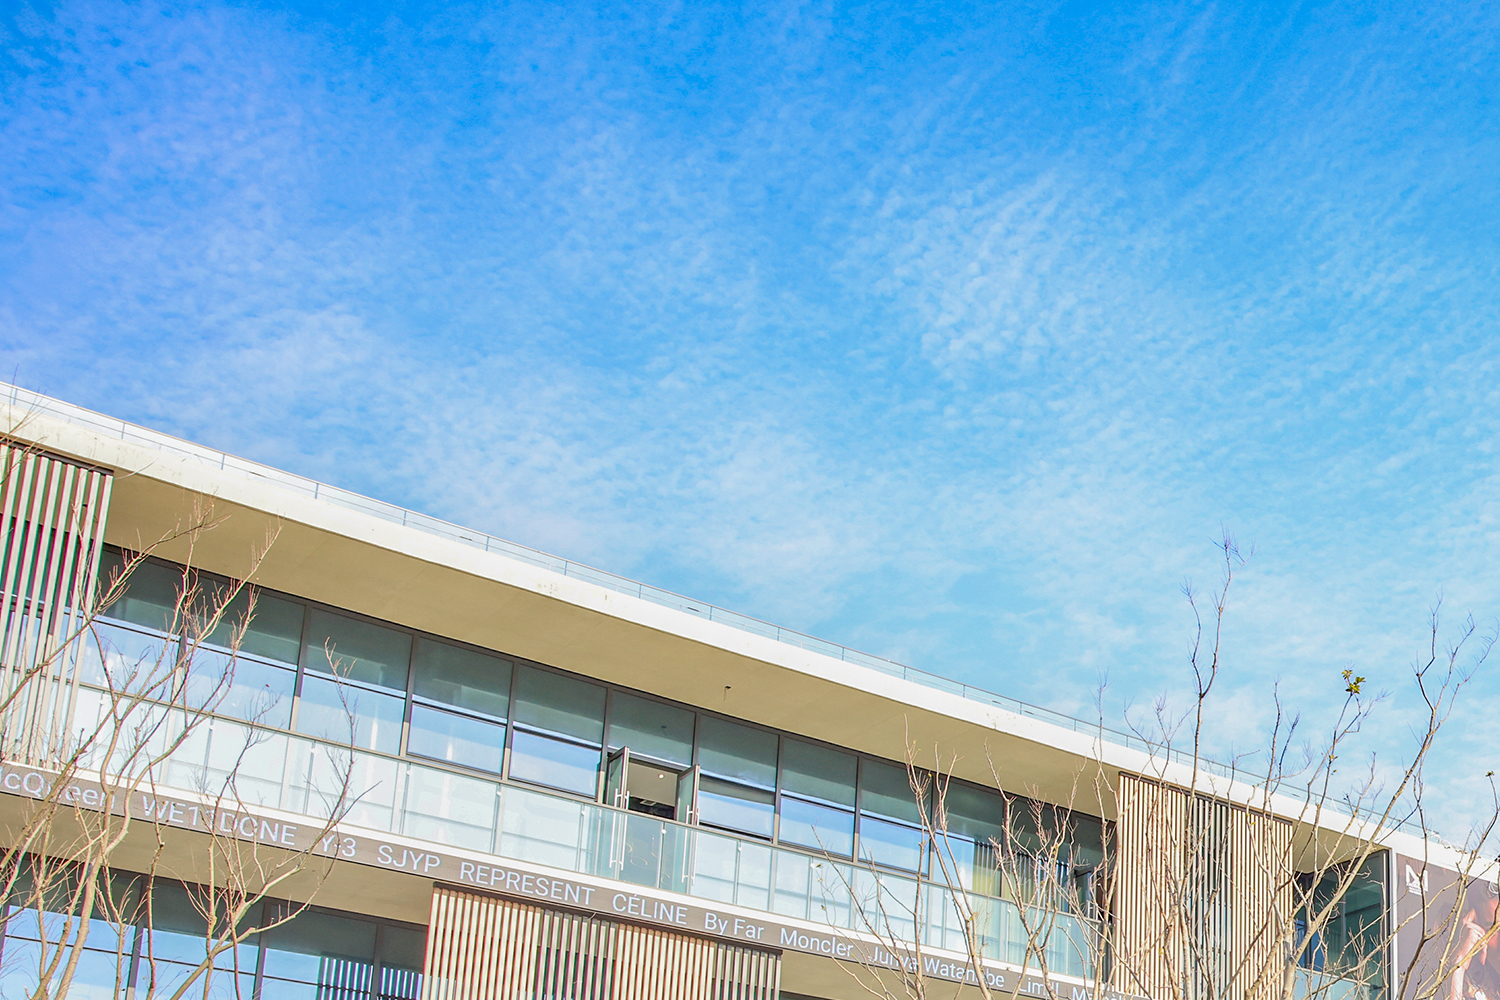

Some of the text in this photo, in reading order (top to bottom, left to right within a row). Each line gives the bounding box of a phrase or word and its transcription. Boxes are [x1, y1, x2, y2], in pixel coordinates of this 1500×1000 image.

[377, 845, 441, 873] SJYP
[460, 862, 596, 906] REPRESENT
[612, 888, 688, 925] CÉLINE
[704, 912, 729, 935] By
[734, 917, 765, 940] Far
[780, 927, 855, 958] Moncler
[924, 957, 1005, 987] Watanbe
